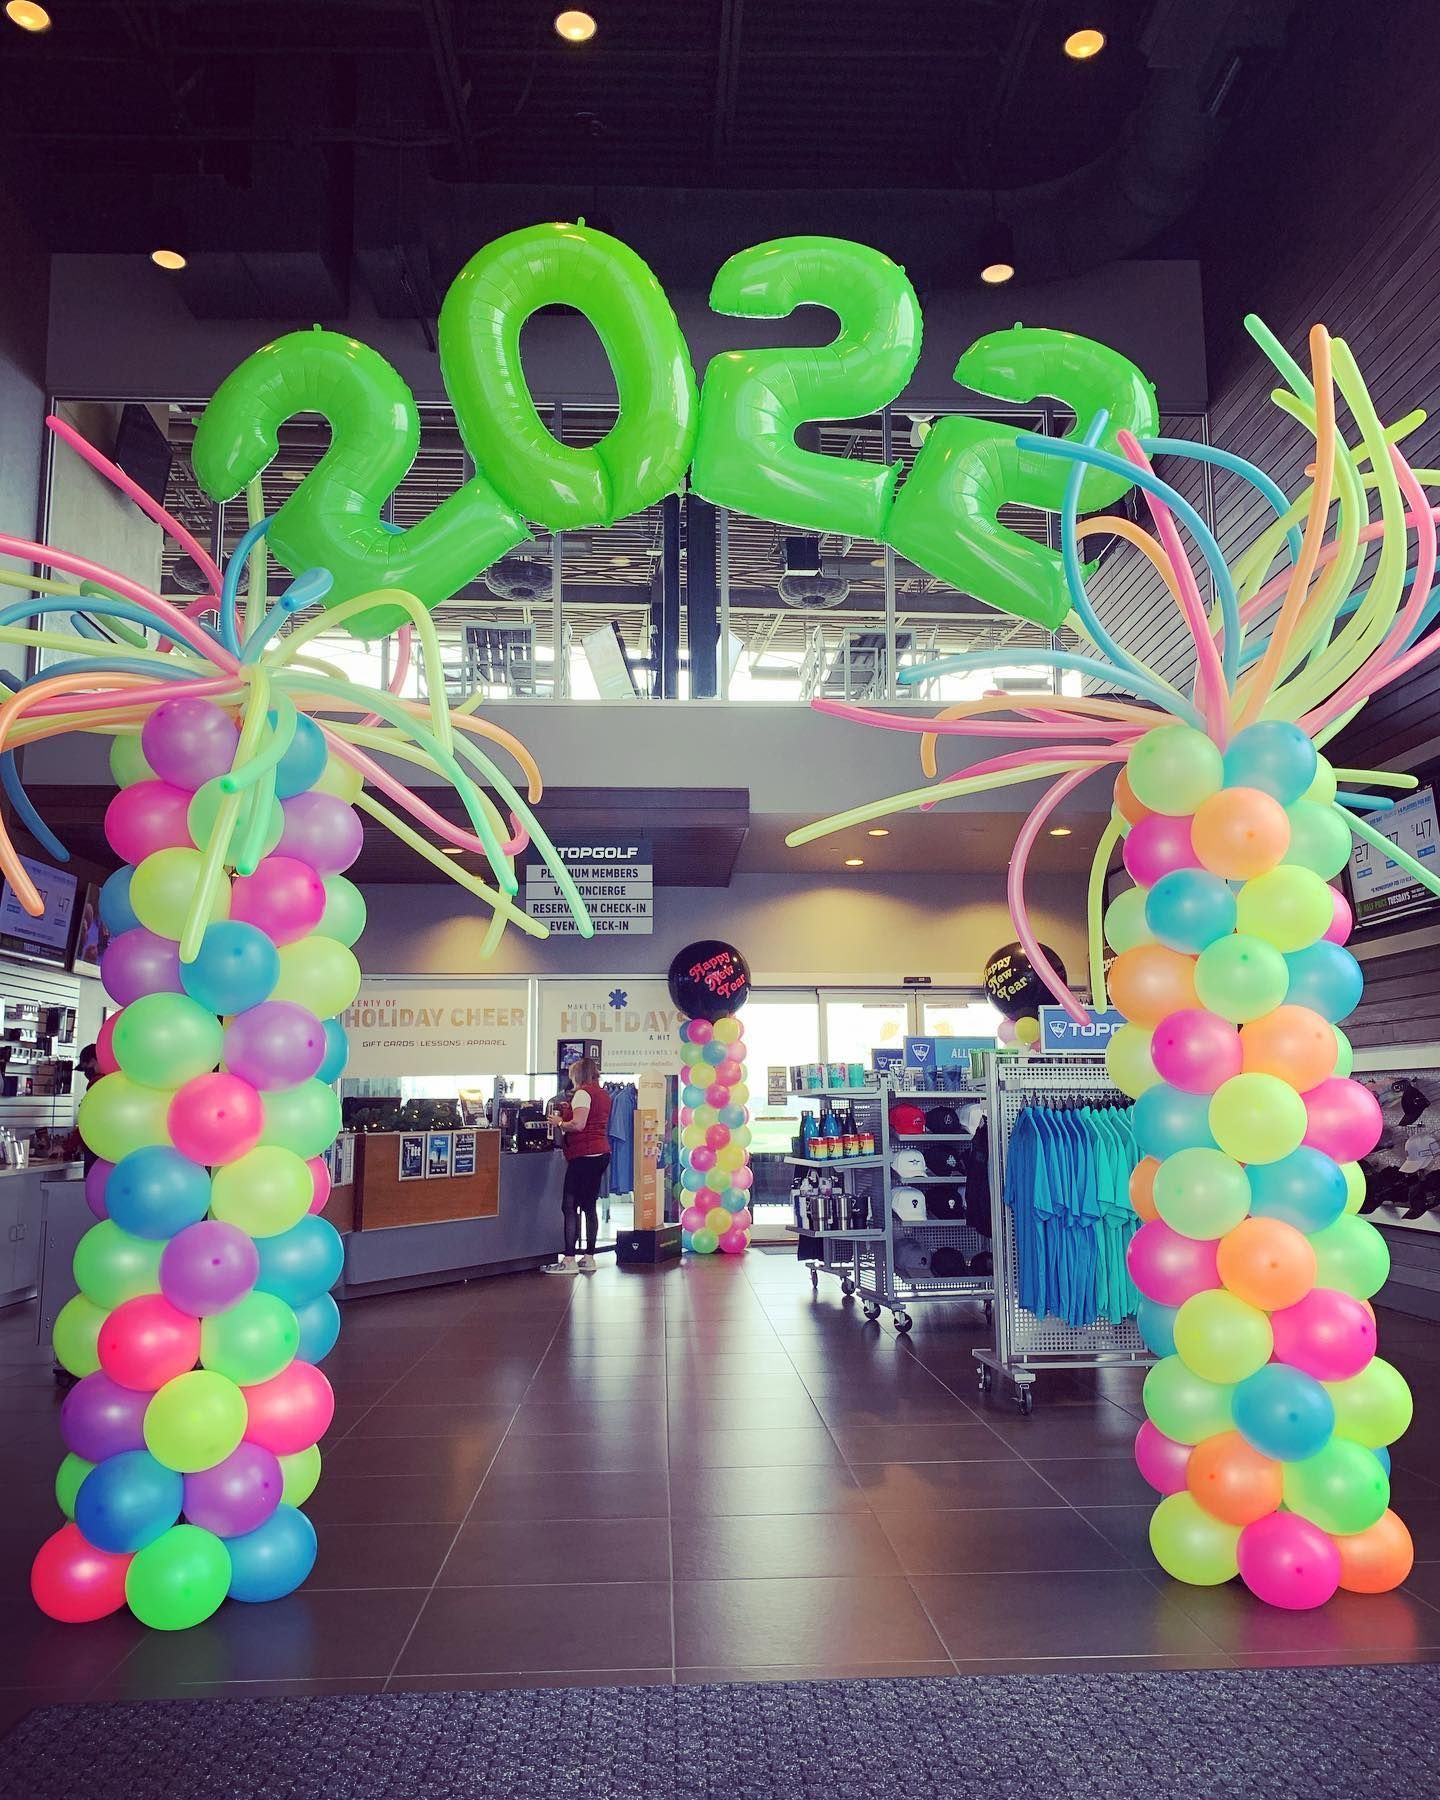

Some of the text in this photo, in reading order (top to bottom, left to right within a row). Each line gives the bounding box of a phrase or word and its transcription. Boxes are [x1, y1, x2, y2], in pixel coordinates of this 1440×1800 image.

[191, 216, 1160, 640] 2022
[557, 847, 638, 859] TOPGOLF
[541, 868, 638, 878] PLNUM MEMBERS
[1387, 891, 1411, 906] TUESDAYS
[533, 903, 646, 914] RESERVON CHECK-IN
[689, 952, 731, 983] Happy
[704, 964, 734, 992] New
[716, 973, 746, 998] Year
[988, 968, 1012, 995] New
[997, 976, 1028, 1001] Year
[351, 999, 397, 1008] LENTY OF
[567, 1003, 588, 1011] MAKE
[344, 1007, 526, 1028] HOLIDAY CHEER
[362, 1040, 381, 1048] GIFT
[383, 1039, 415, 1047] CARDS
[466, 1039, 508, 1047] APPAREL
